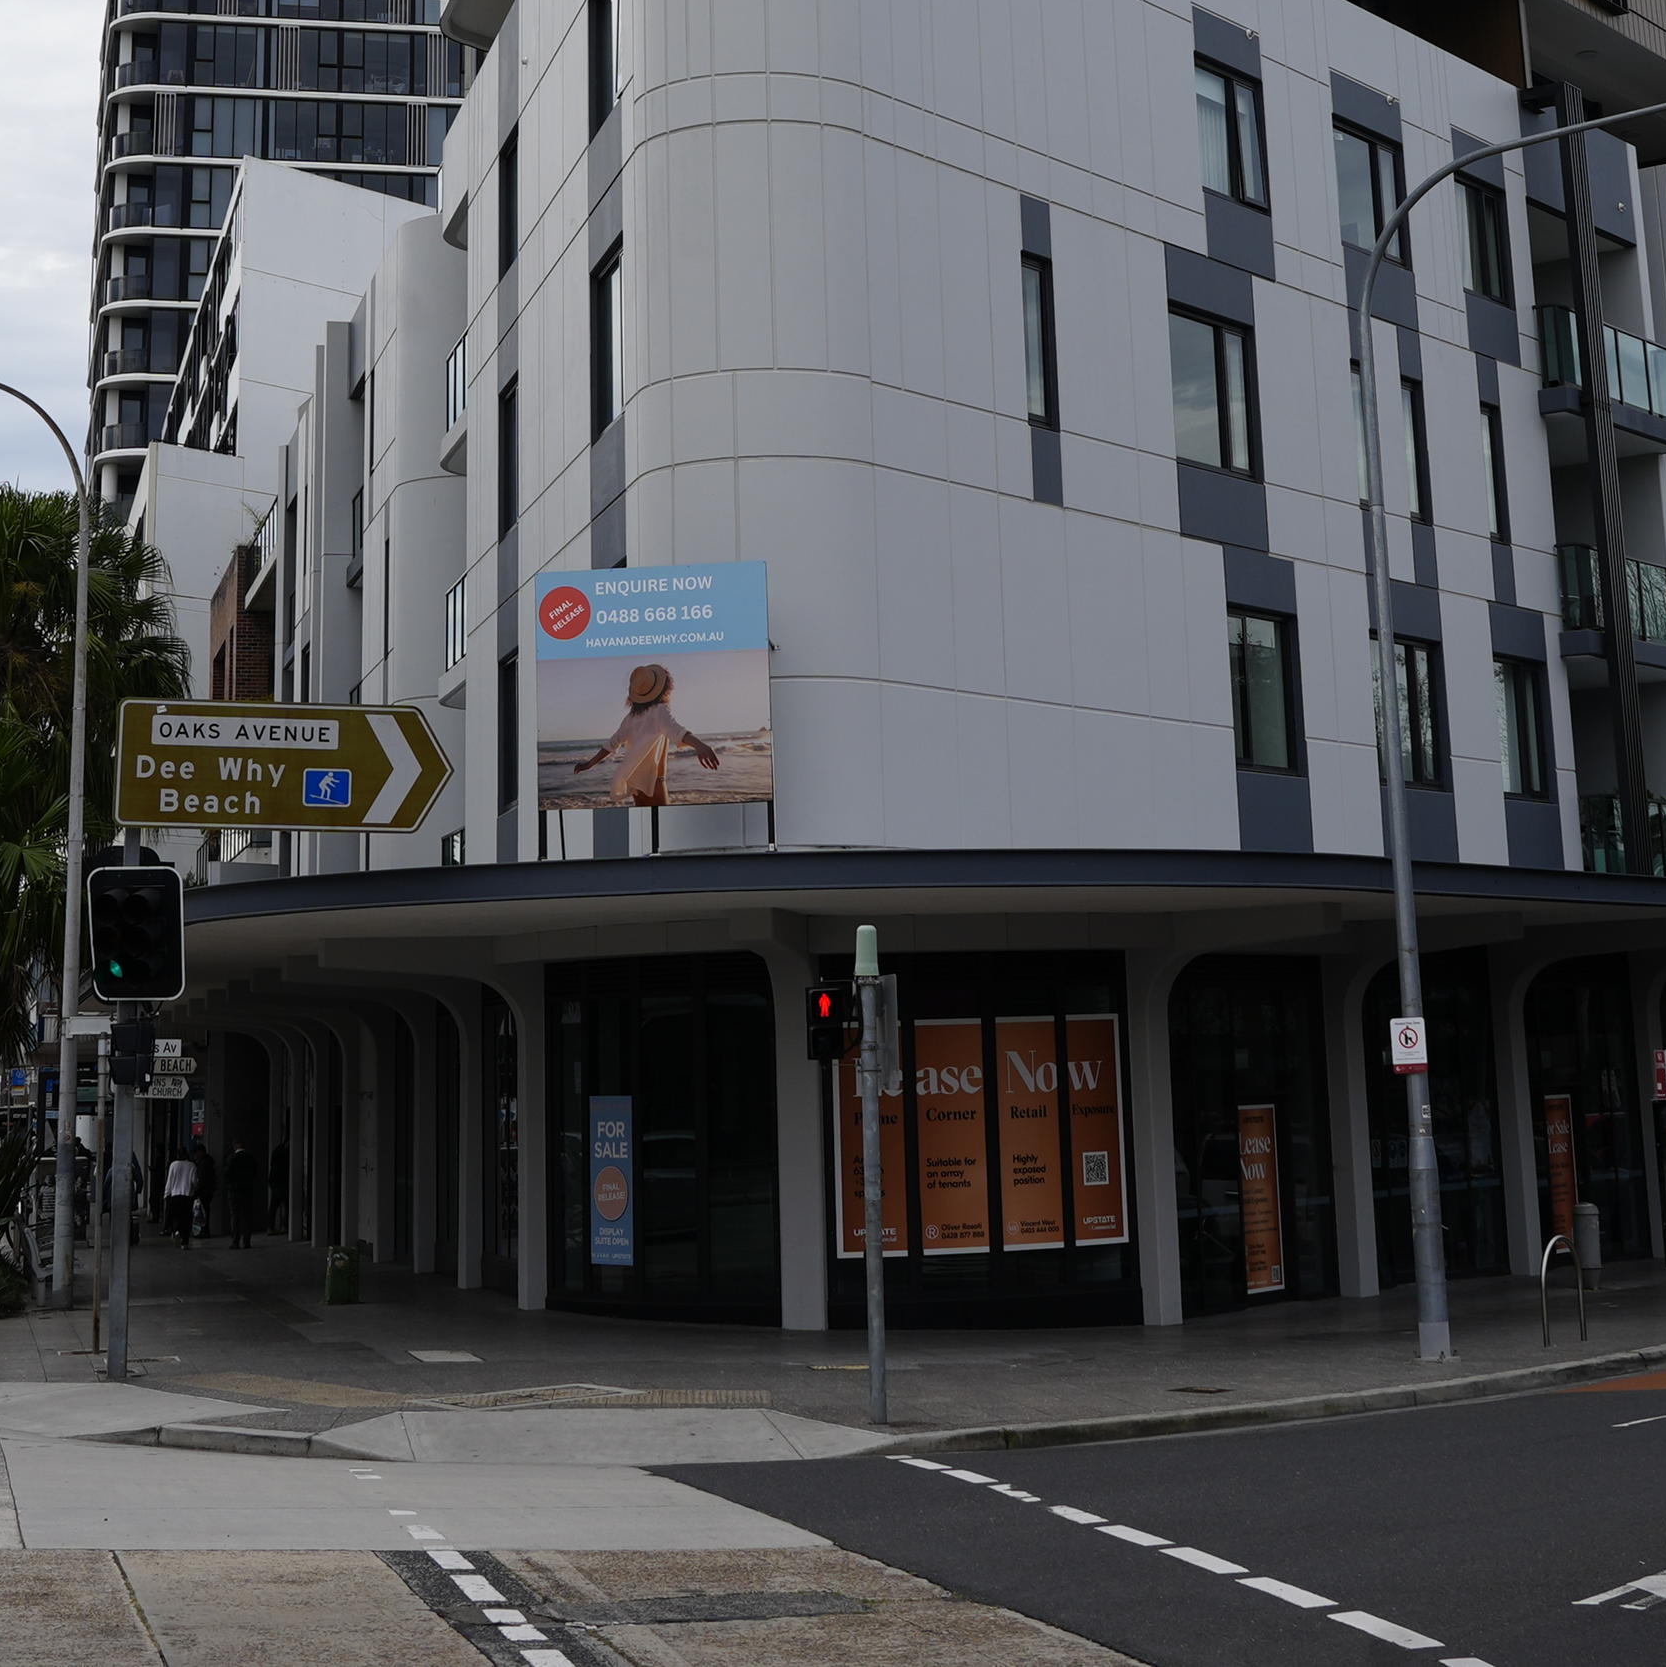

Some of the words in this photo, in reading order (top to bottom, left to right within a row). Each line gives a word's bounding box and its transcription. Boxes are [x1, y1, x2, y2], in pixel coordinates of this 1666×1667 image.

[595, 579, 668, 597] ENQUIRE
[673, 576, 713, 591] NOW
[549, 599, 573, 620] FINAL
[552, 604, 585, 632] RELEASE
[596, 607, 640, 625] 0488
[644, 606, 677, 622] 668
[681, 604, 713, 620] 166
[586, 631, 724, 648] HAVANADEEWHY.COM.AU
[159, 721, 221, 739] OAKS
[235, 723, 330, 742] AVENUE
[136, 754, 195, 780] Dee
[218, 756, 286, 788] Why
[159, 788, 261, 814] Beach
[163, 1041, 177, 1053] Av
[160, 1059, 192, 1072] BEACH
[1005, 1049, 1103, 1094] Now
[152, 1086, 182, 1096] CHURCH
[926, 1107, 977, 1122] Corner
[1010, 1104, 1047, 1119] Retail
[1072, 1103, 1117, 1118] Exposure
[597, 1121, 626, 1138] FOR
[594, 1141, 629, 1159] SALE
[1238, 1133, 1272, 1155] Lease
[926, 1157, 962, 1168] Suitable
[964, 1156, 976, 1166] for
[1012, 1153, 1038, 1165] Highly
[926, 1170, 938, 1179] an
[940, 1169, 965, 1179] array
[1013, 1164, 1046, 1175] exposed
[927, 1179, 936, 1190] of
[938, 1179, 972, 1189] tenants
[1013, 1175, 1045, 1187] position
[941, 1222, 960, 1231] Oliver
[1083, 1215, 1117, 1225] UPSTATE
[612, 1237, 629, 1246] OPEN
